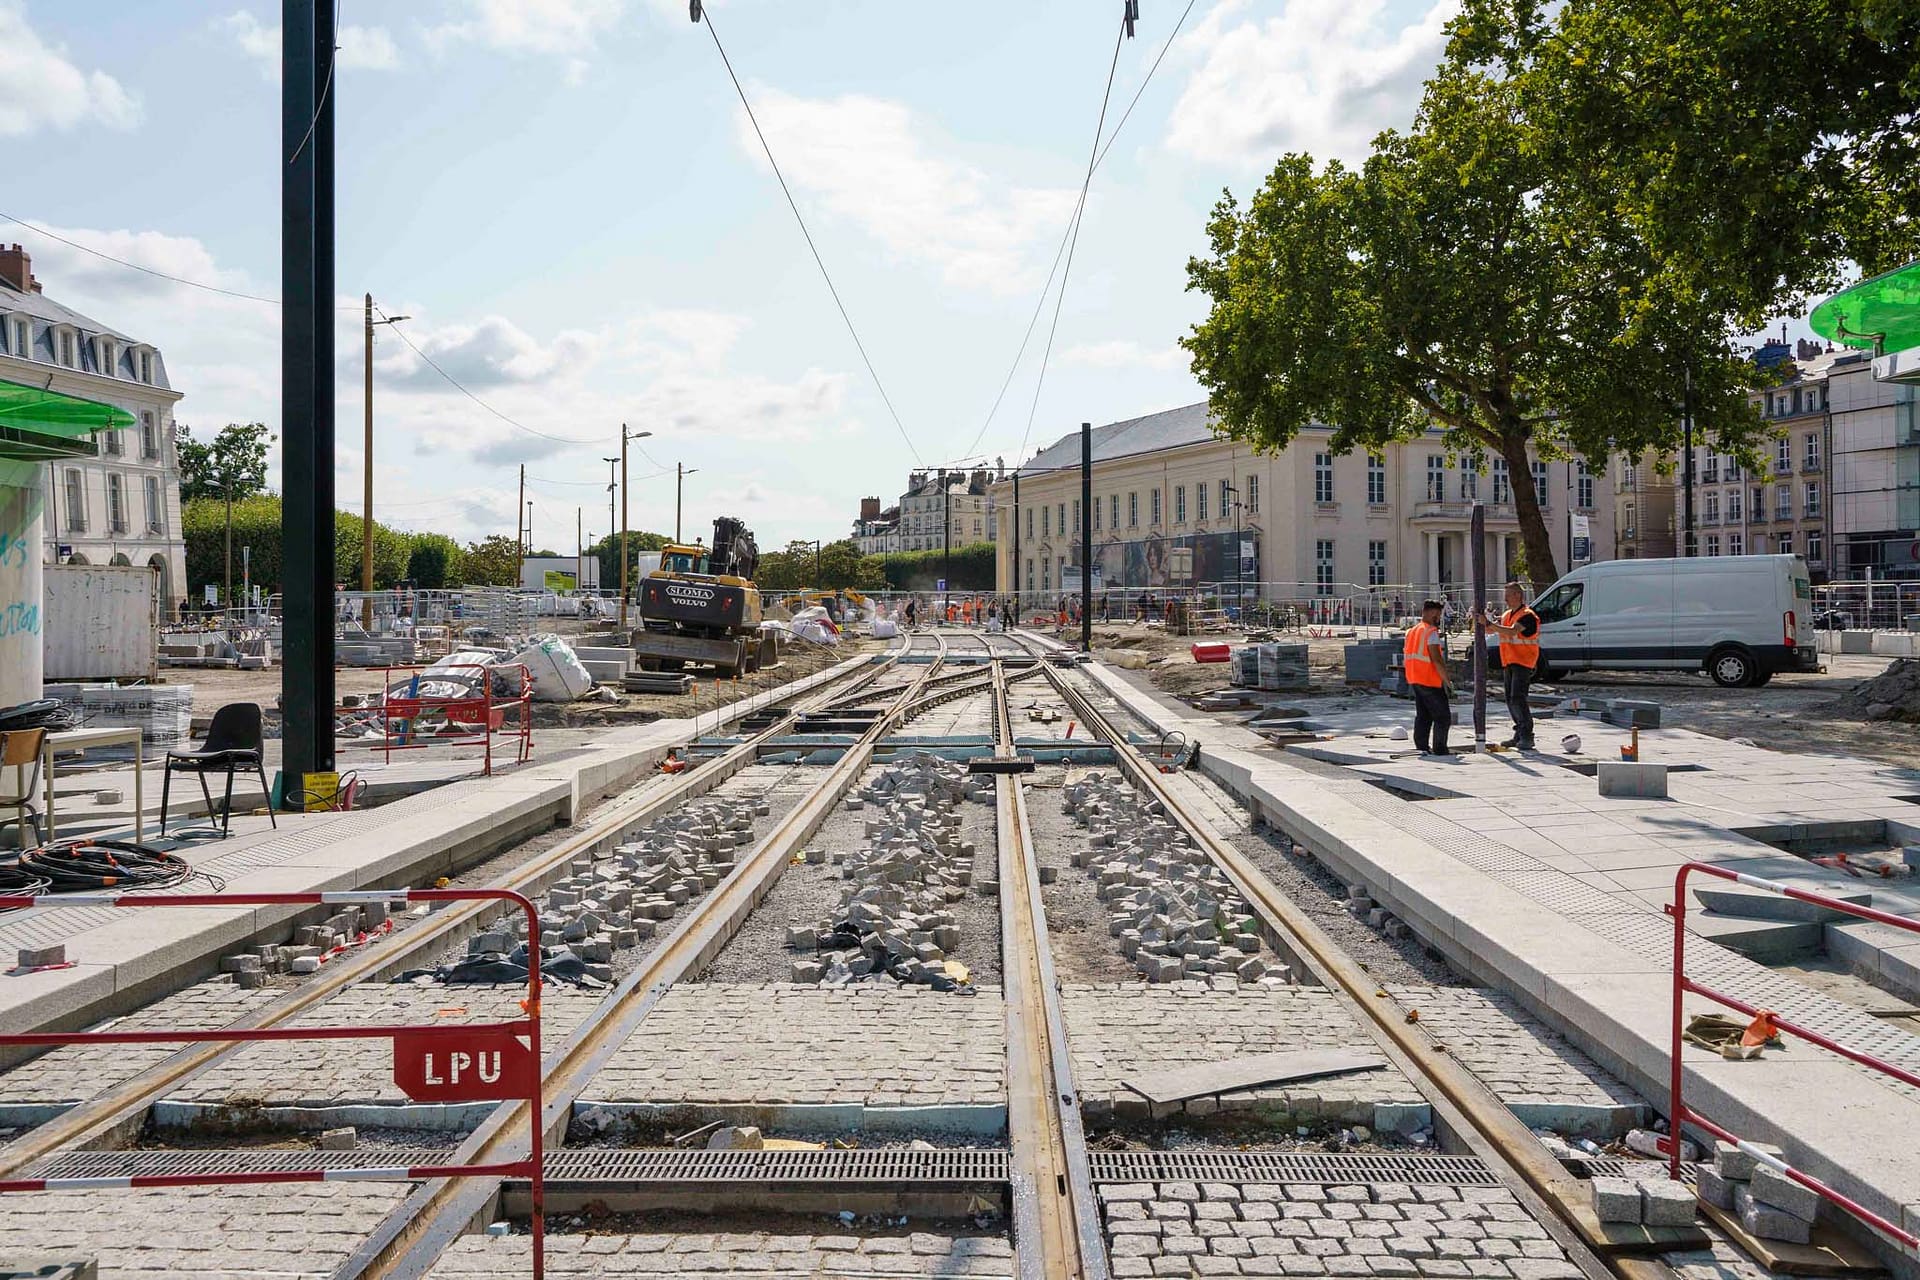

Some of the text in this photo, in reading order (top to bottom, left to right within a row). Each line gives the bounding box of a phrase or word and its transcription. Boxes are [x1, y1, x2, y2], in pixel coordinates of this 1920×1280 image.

[669, 587, 711, 598] SLOMA
[671, 598, 708, 607] VOLVO
[425, 1051, 502, 1086] LPU
